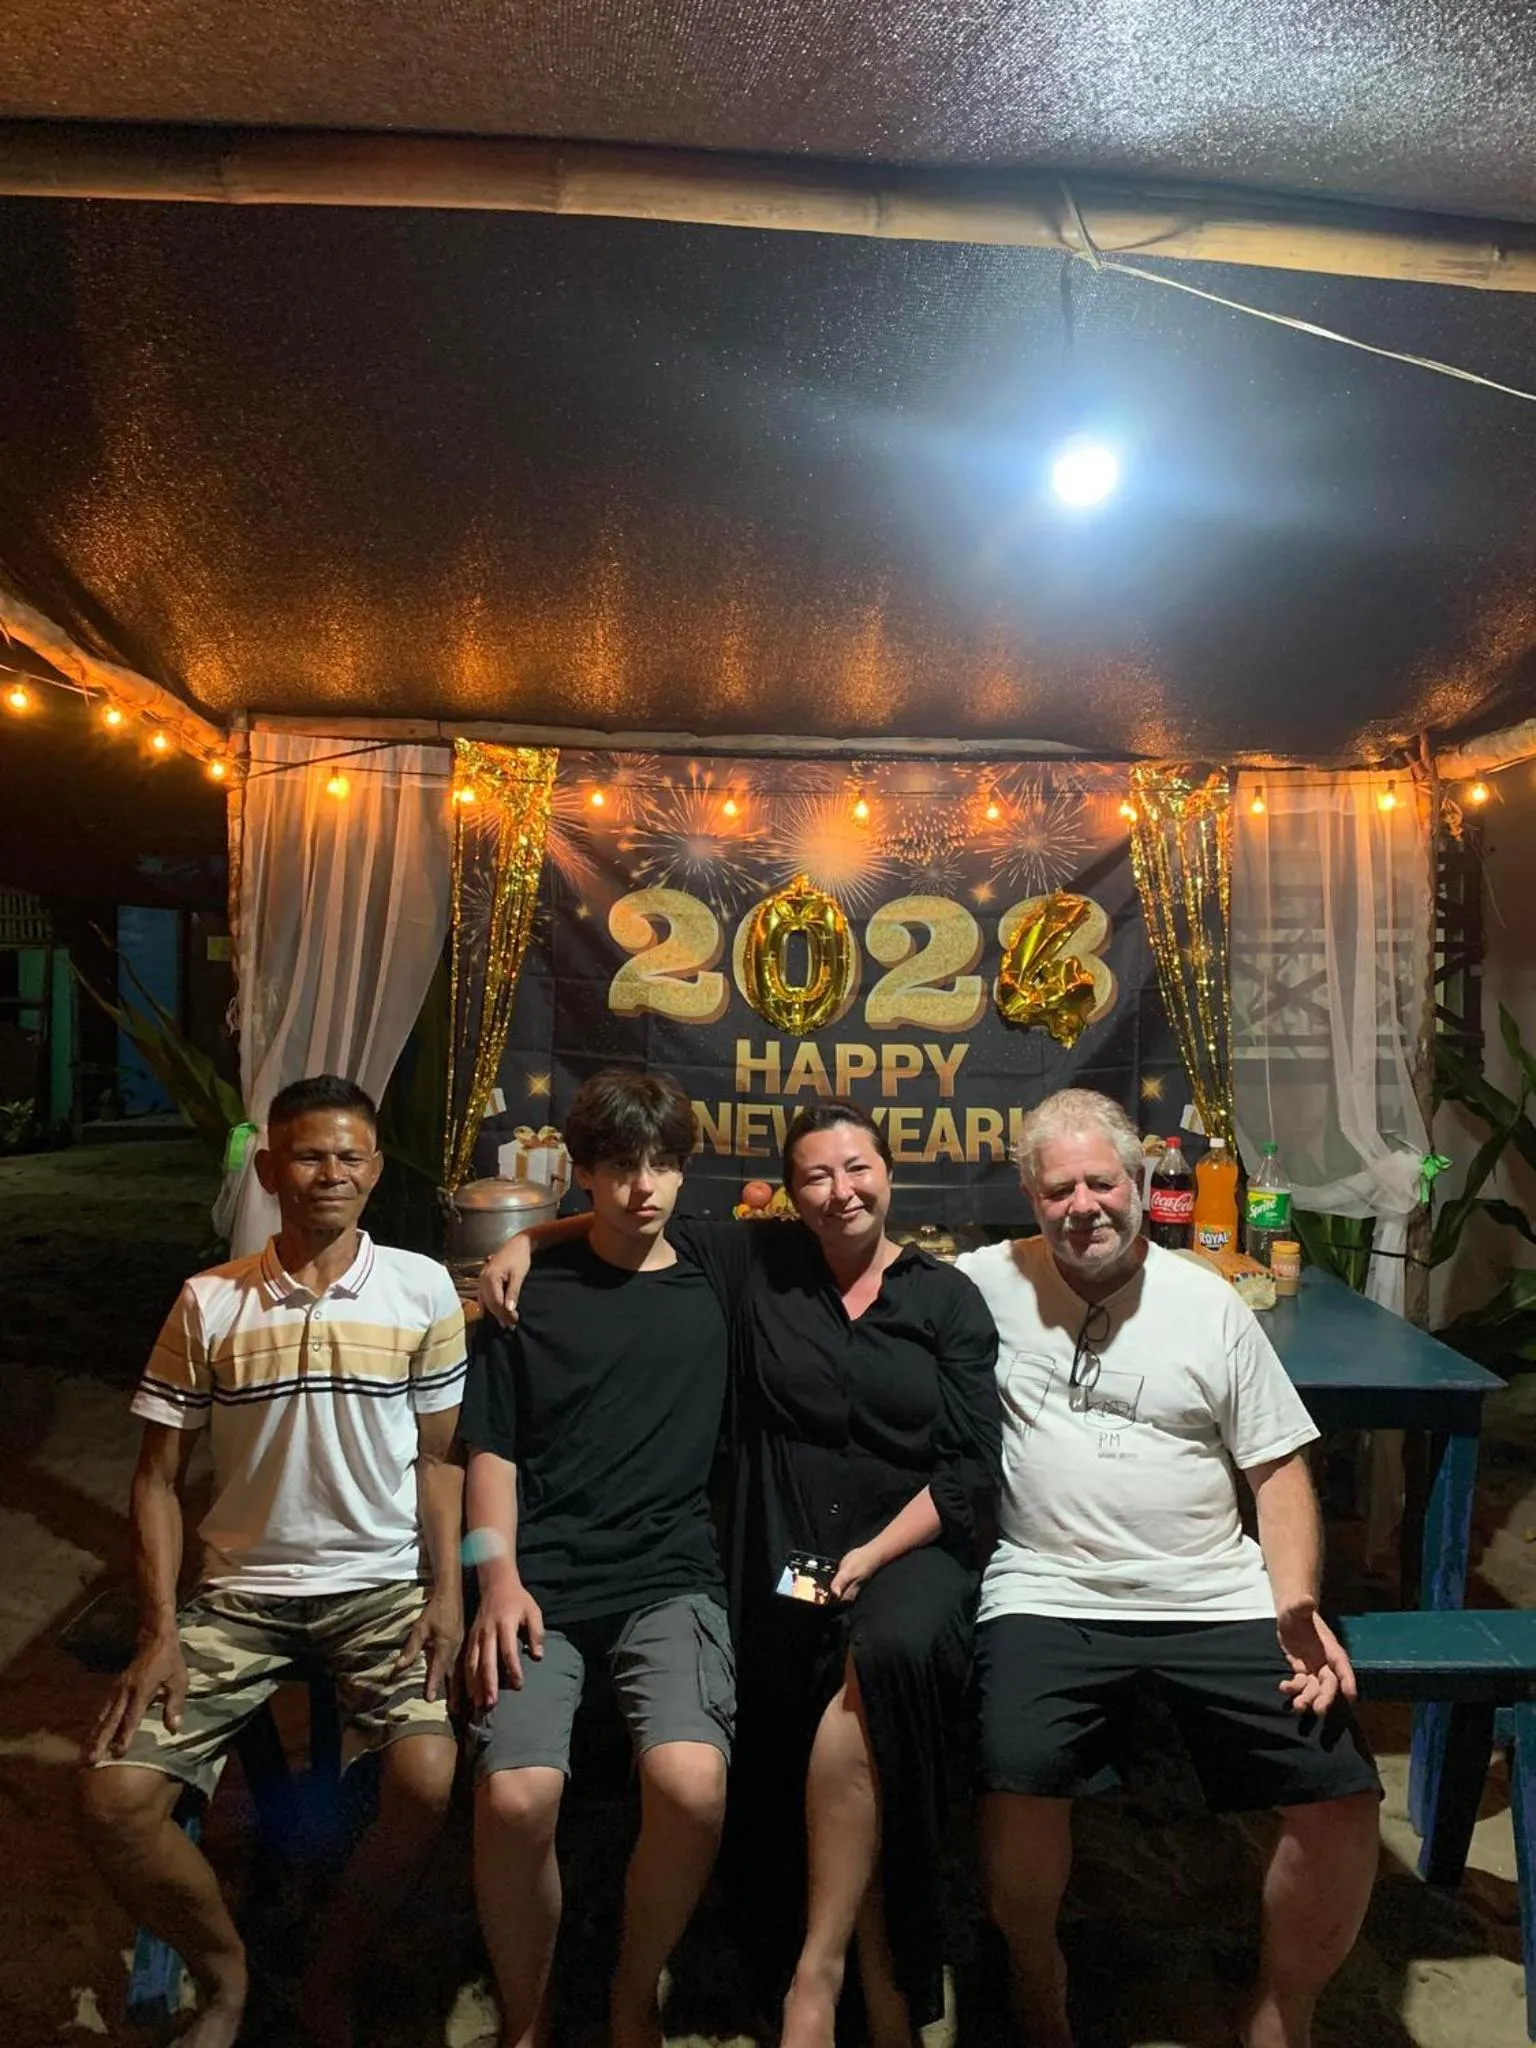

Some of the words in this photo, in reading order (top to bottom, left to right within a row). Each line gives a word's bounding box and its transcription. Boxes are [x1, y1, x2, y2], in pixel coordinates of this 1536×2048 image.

[735, 1039, 970, 1098] HAPPY
[871, 1107, 1024, 1163] EAR!
[1249, 1199, 1277, 1219] Sprite
[1199, 1231, 1229, 1244] ROYAL
